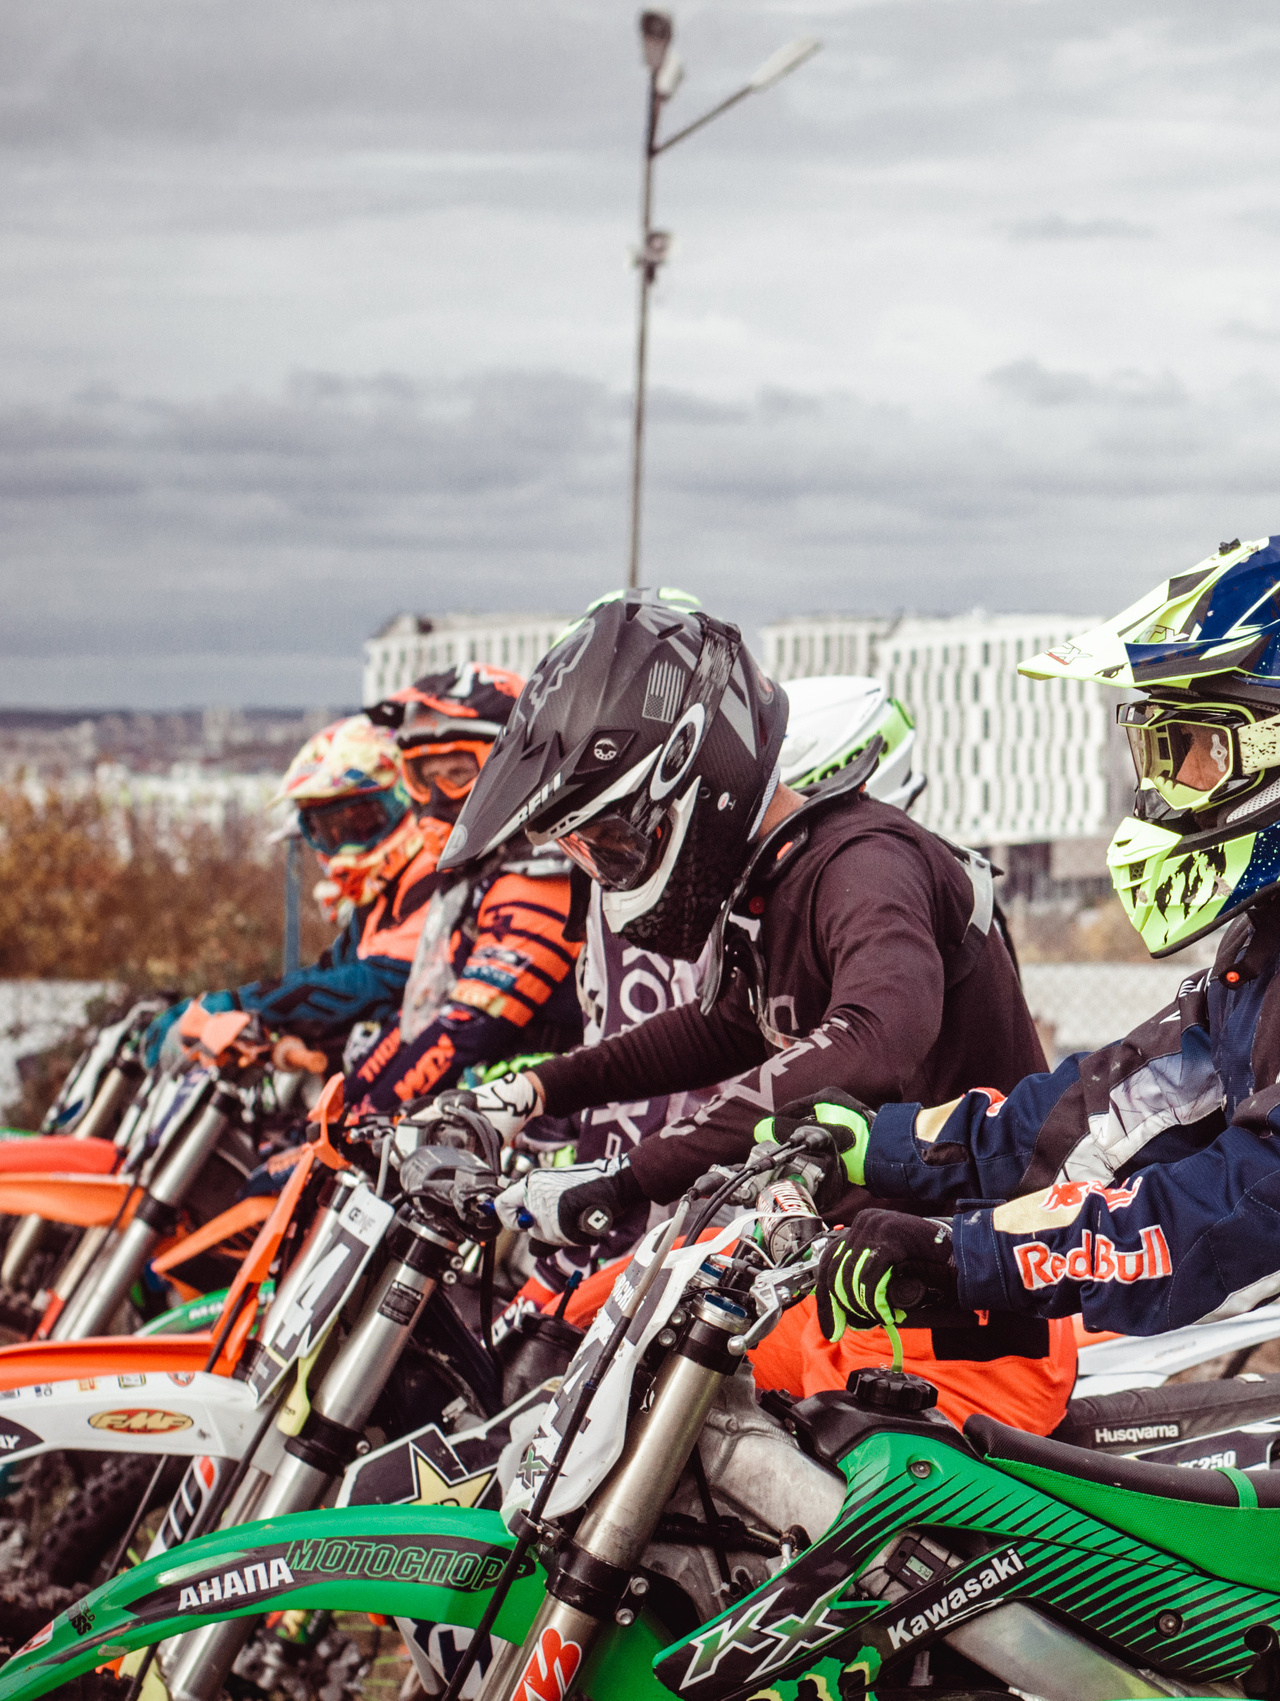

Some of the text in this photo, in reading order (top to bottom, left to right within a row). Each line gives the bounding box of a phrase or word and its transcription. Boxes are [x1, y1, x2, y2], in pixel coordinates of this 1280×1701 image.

[98, 1410, 189, 1431] FMF
[1094, 1423, 1180, 1444] Husqvarna
[177, 1539, 526, 1611] АНАПА МОТОСПОР
[886, 1548, 1026, 1650] Kawasaki
[679, 1572, 856, 1690] KX
